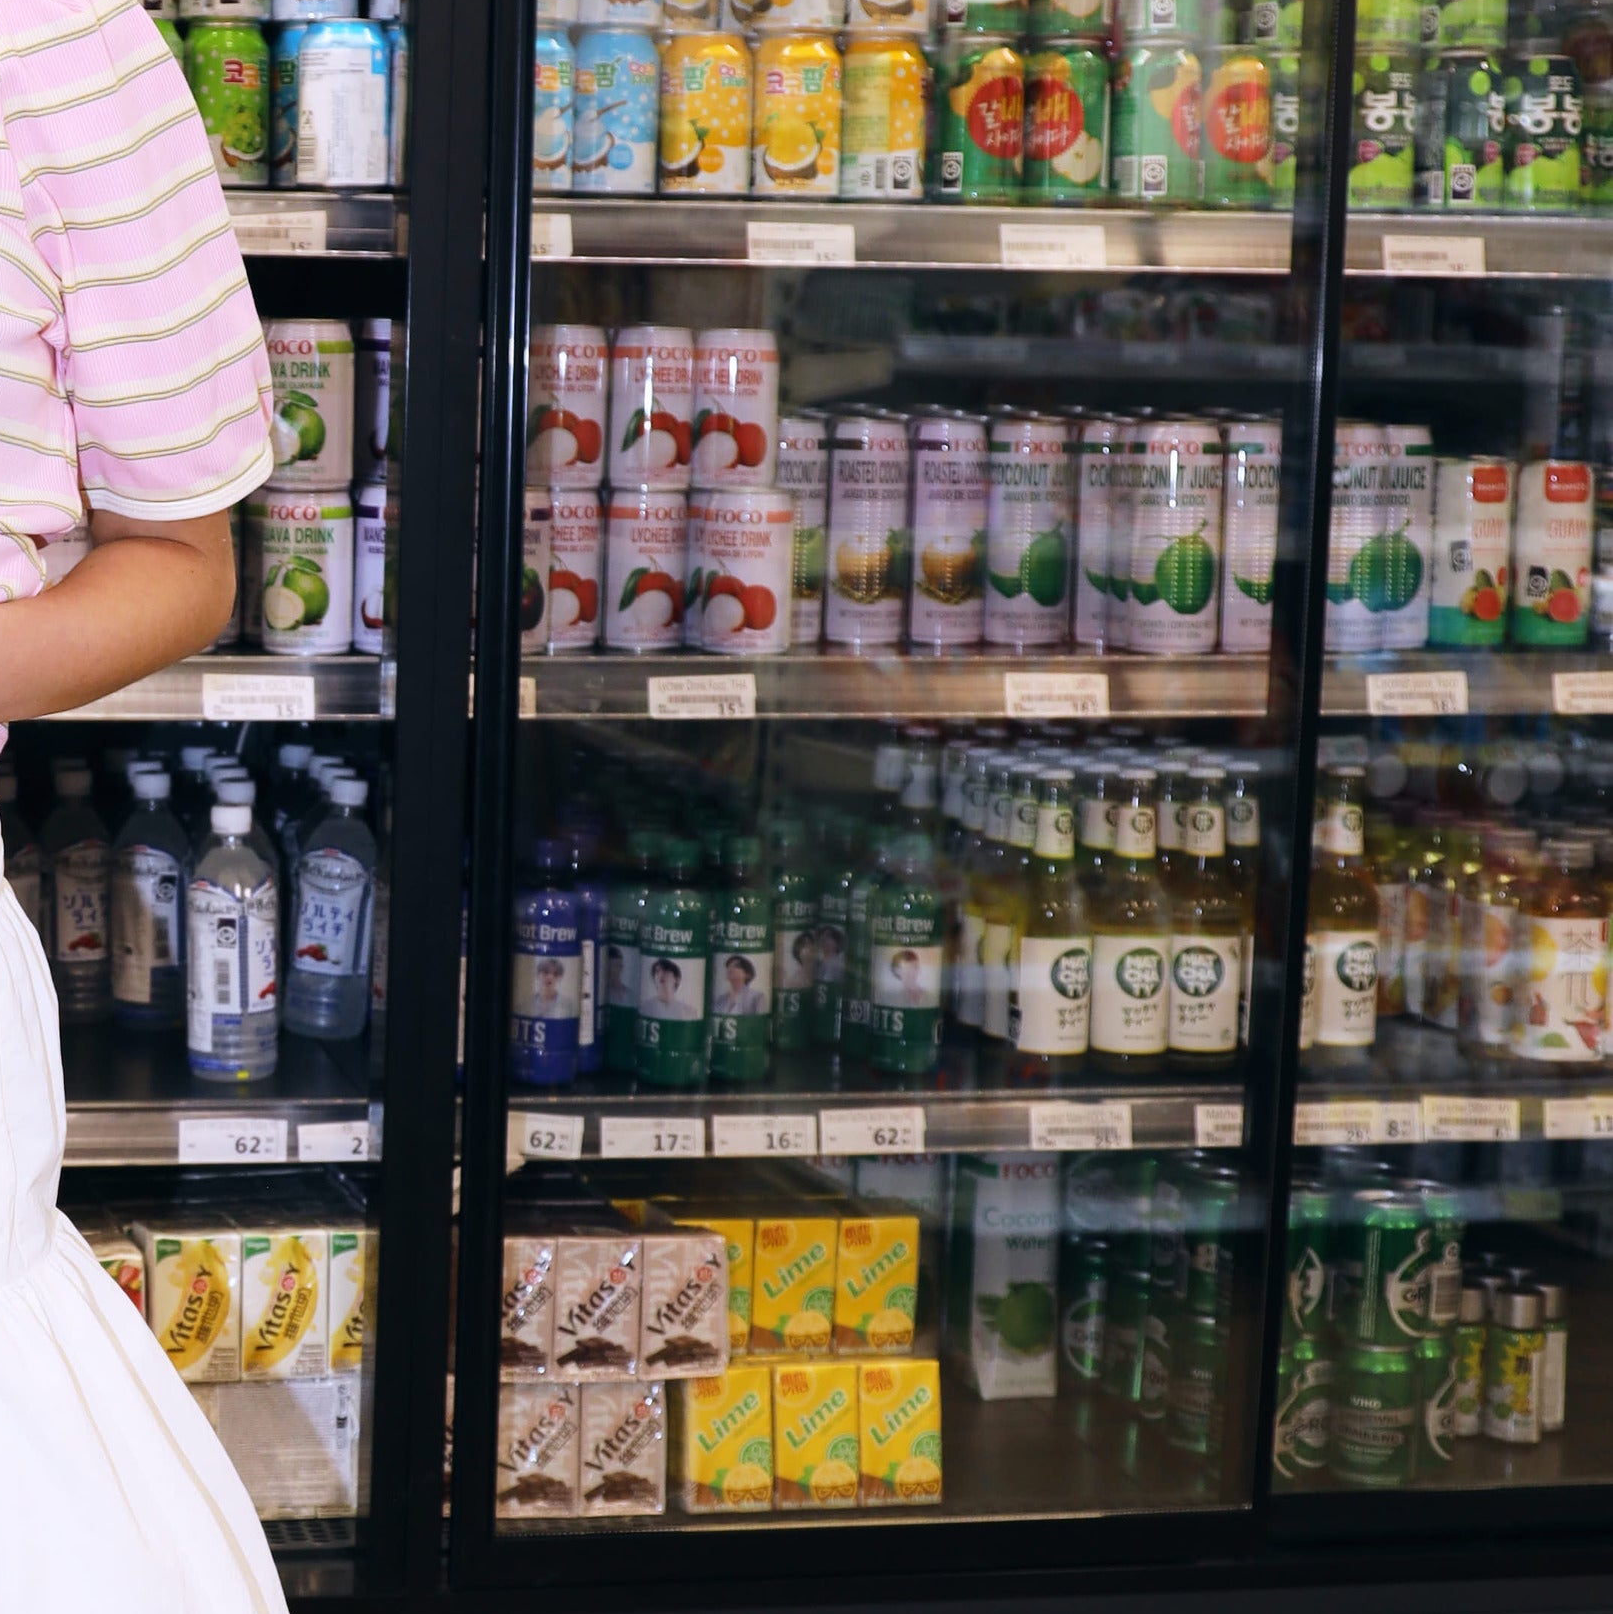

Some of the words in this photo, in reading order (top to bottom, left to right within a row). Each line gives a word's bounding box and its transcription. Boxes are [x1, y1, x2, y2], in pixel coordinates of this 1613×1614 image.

[546, 345, 595, 359] FOCO
[290, 361, 331, 378] DRINK
[270, 505, 317, 521] FOCO
[715, 509, 763, 524] FOCO
[295, 527, 334, 544] DRINK
[741, 531, 772, 548] DRINK
[304, 918, 343, 936] ライチ
[539, 924, 577, 943] Brew
[727, 922, 767, 940] Brew
[896, 916, 935, 933] Brew
[654, 927, 694, 944] Brew
[873, 1128, 899, 1146] 62
[1387, 1119, 1399, 1137] 8
[235, 1136, 261, 1154] 62
[529, 1130, 555, 1150] 62
[653, 1133, 679, 1152] 17
[765, 1132, 791, 1150] 16
[1000, 1162, 1058, 1180] FOCO
[987, 1207, 1060, 1227] Cocon
[762, 1241, 827, 1301] Lime
[845, 1239, 908, 1299] Lime
[696, 1391, 760, 1455] Lime
[785, 1389, 848, 1450] Lime
[869, 1385, 932, 1447] Lime
